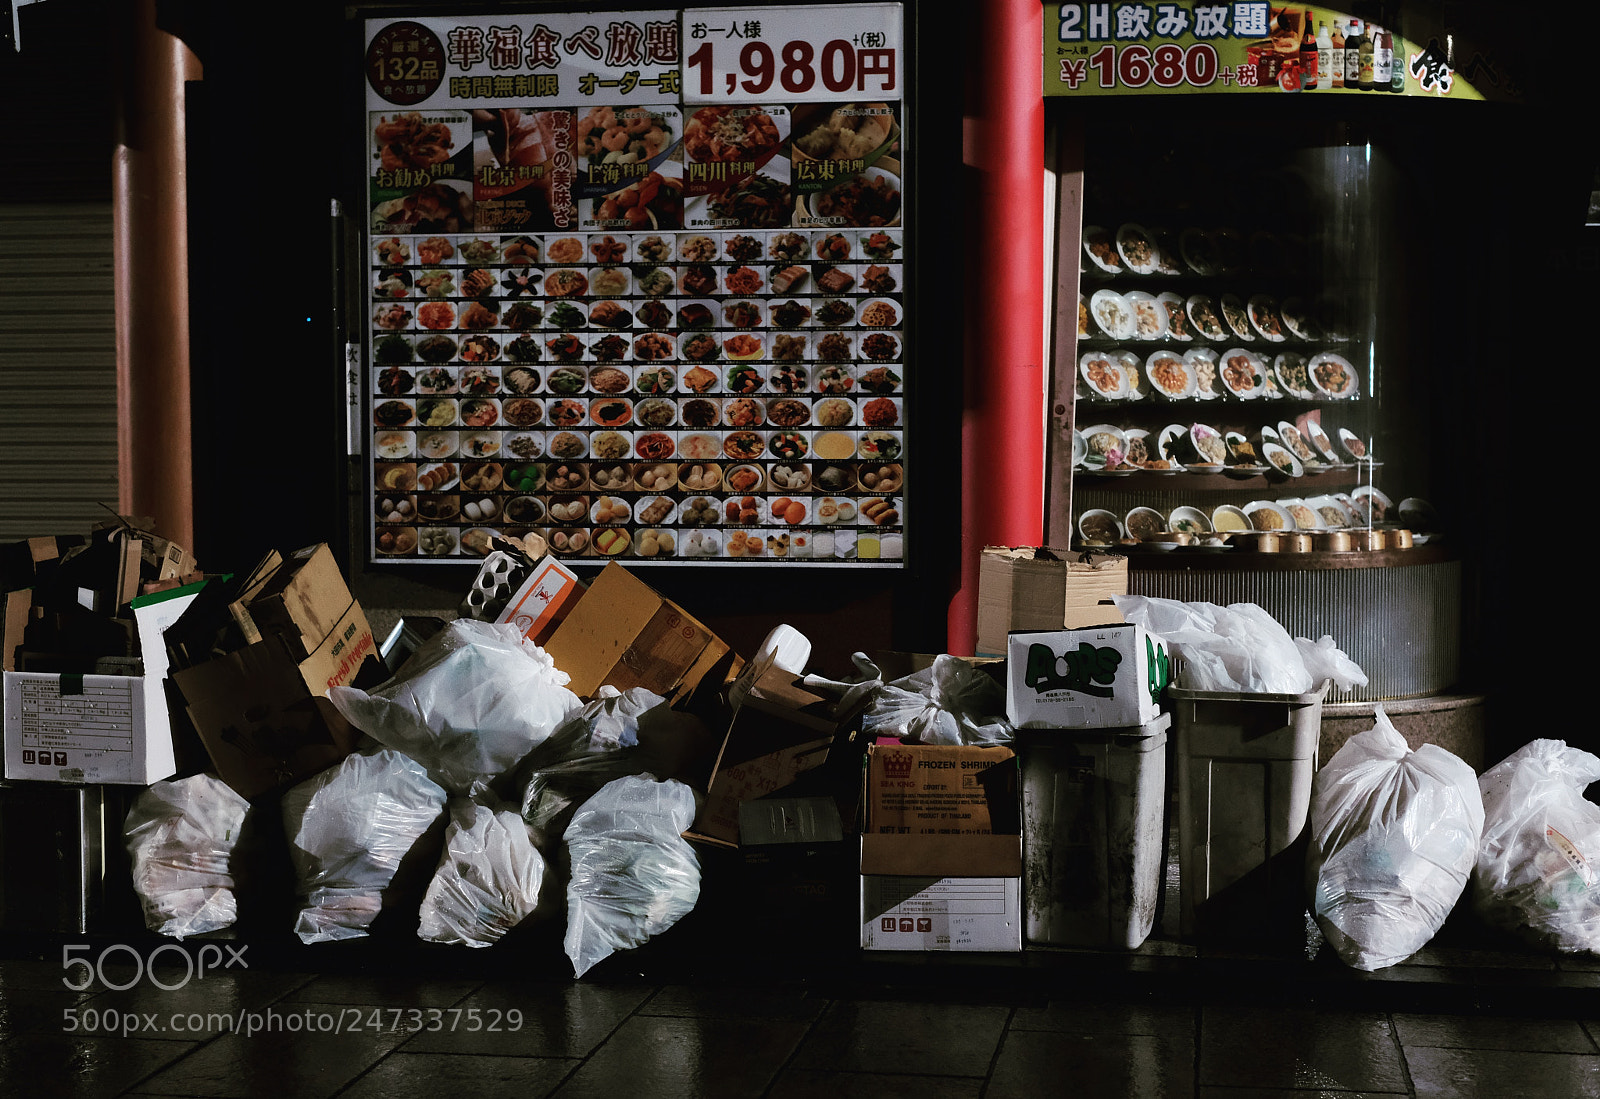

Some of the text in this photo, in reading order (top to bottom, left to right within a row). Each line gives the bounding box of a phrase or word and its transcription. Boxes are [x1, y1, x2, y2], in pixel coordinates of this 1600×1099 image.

[691, 21, 761, 39] お一人様
[1059, 2, 1270, 41] 2H飲み放題
[447, 21, 679, 71] 華福食べ放題
[1057, 47, 1088, 55] お一人様
[373, 58, 437, 81] 132品
[688, 39, 896, 96] 1,980円
[382, 85, 425, 96] 食べ放題
[578, 71, 680, 96] オーダー式
[479, 164, 544, 187] 北京料理
[587, 162, 649, 185] 上海料理
[689, 161, 756, 183] 四川料理
[797, 159, 865, 181] 広東料理
[918, 761, 956, 769] FROZEN
[880, 781, 915, 789] SEA KING
